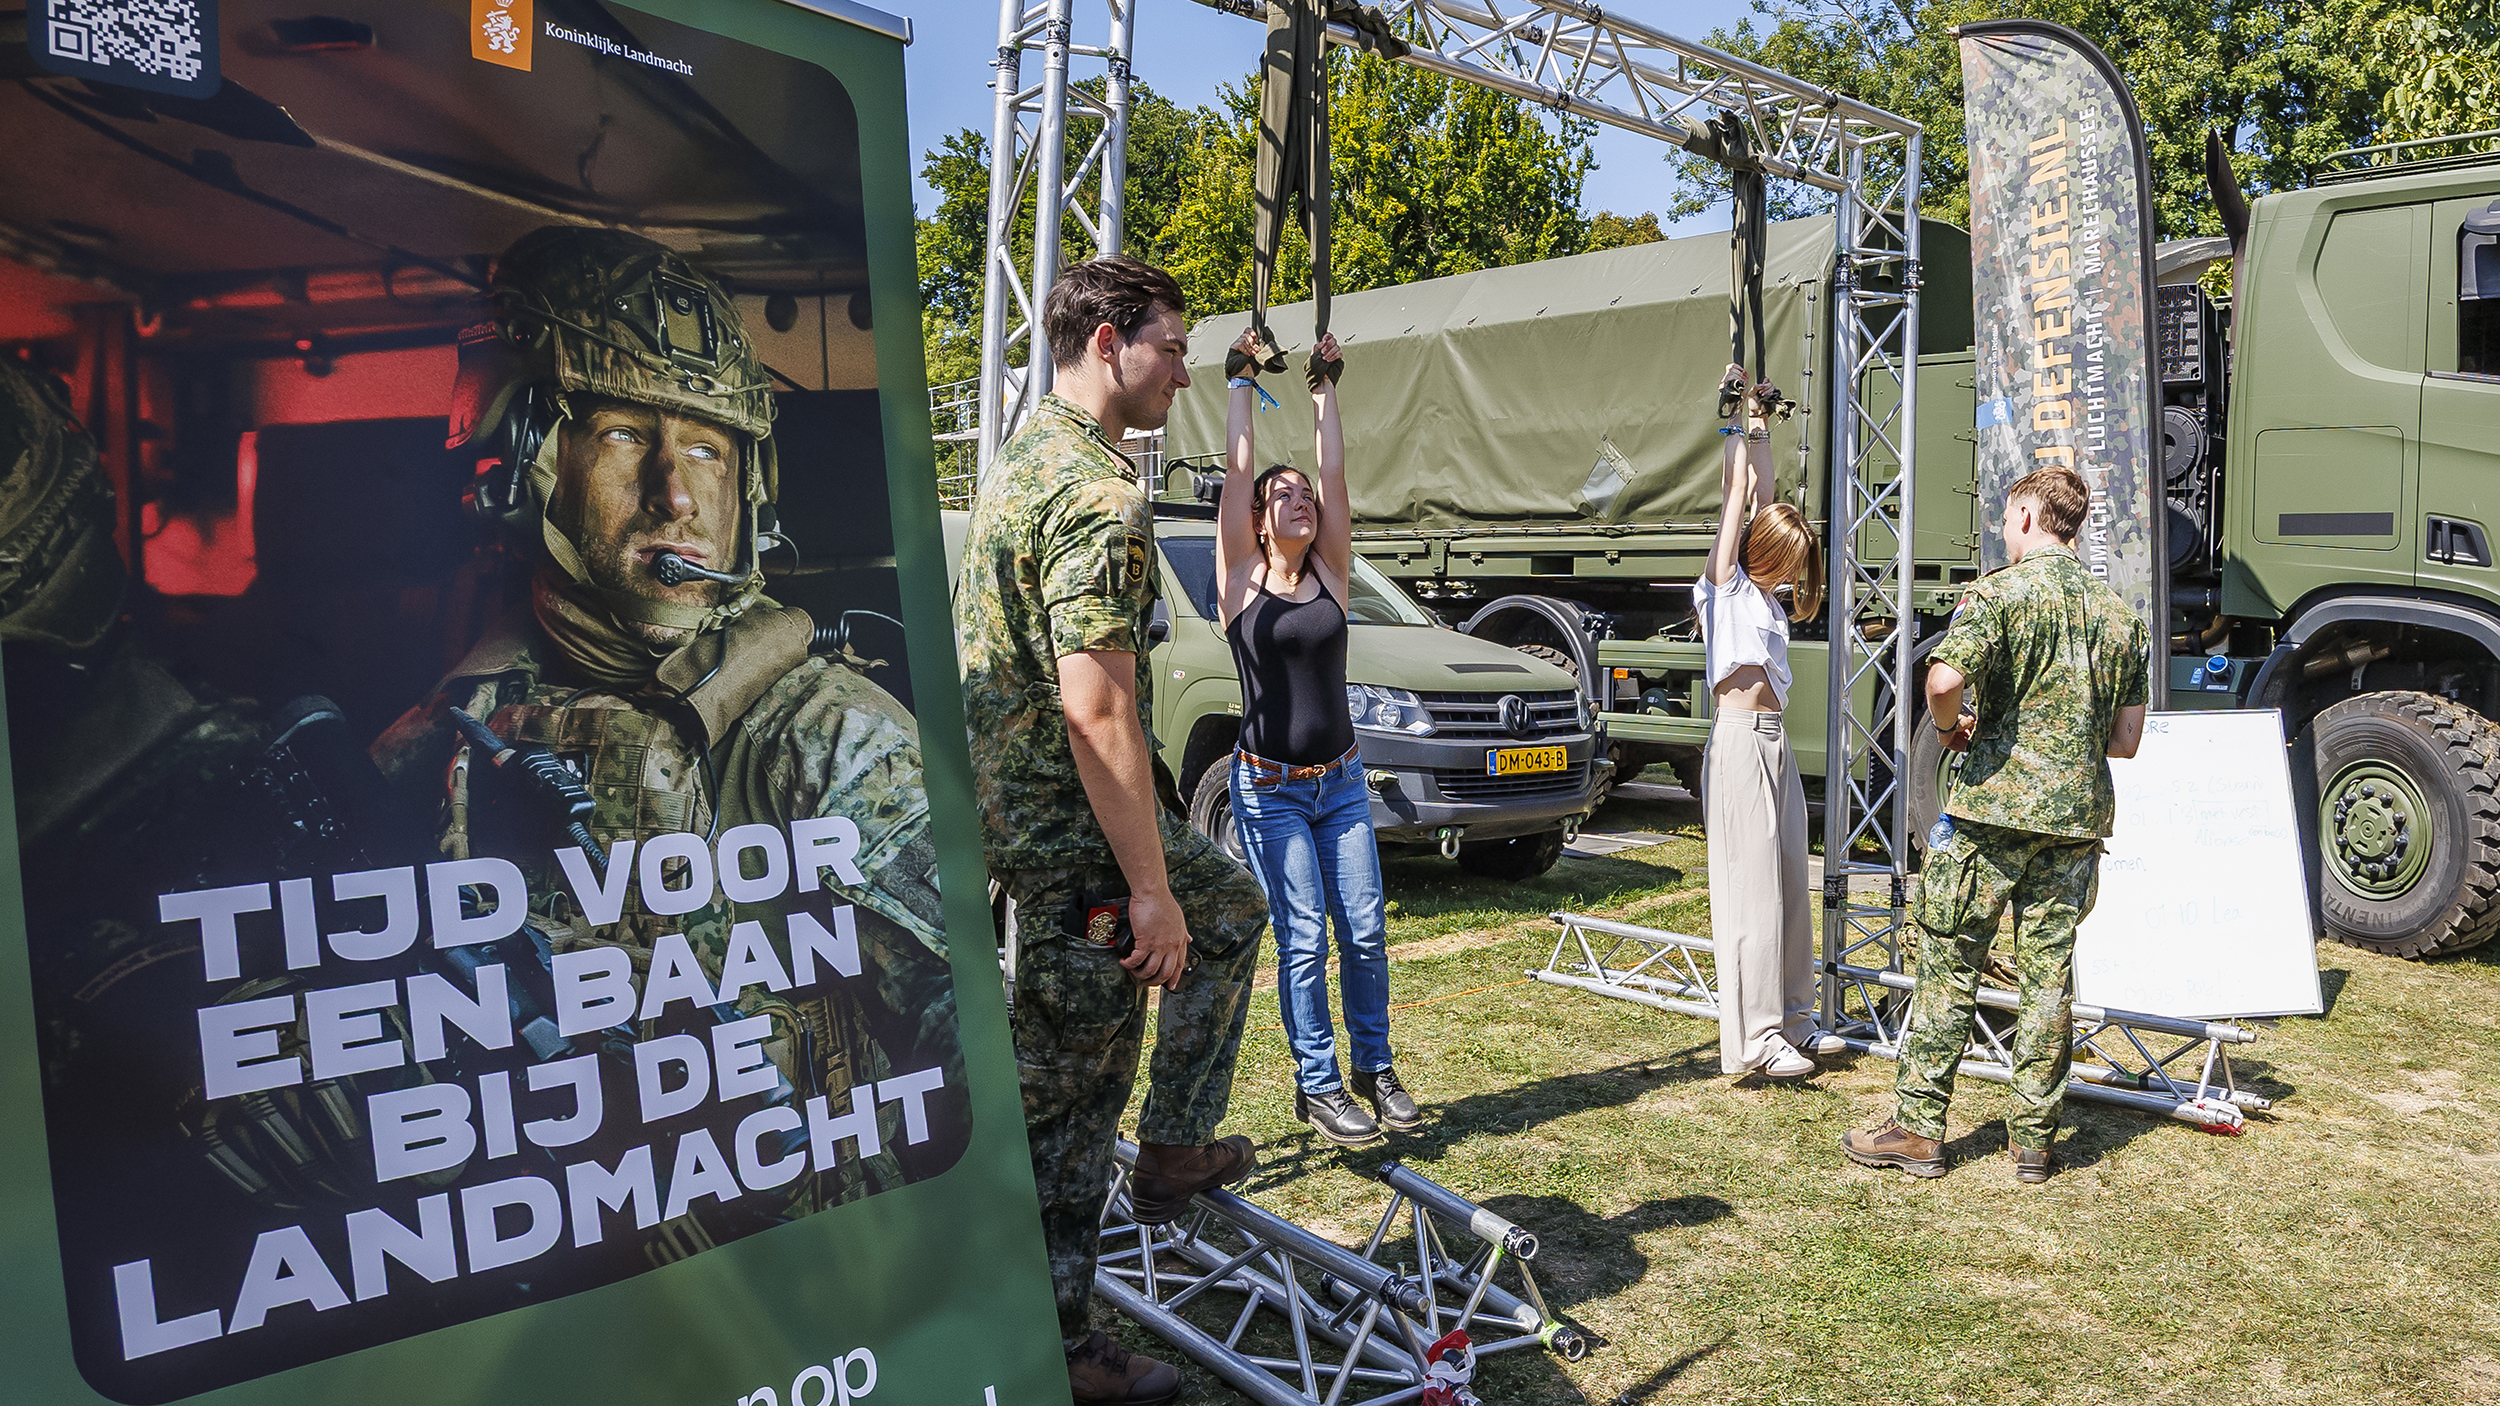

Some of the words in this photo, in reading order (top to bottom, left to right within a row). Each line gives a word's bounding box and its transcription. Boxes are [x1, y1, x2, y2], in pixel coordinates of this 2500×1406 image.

[545, 21, 621, 55] Koninklijke
[623, 44, 694, 76] Landmacht
[2079, 106, 2102, 274] MARECHAUSSEE
[2085, 310, 2106, 451] LUCHTMACHT
[1132, 563, 1140, 576] 13
[1499, 751, 1564, 771] DM-043-B
[158, 856, 529, 983] TIJD
[554, 815, 867, 928] VOOR
[2099, 856, 2148, 873] omen
[197, 963, 513, 1101] EEN
[551, 904, 863, 1038] BAAN
[367, 1053, 604, 1183] BIJ
[634, 1013, 780, 1125] DE
[112, 1066, 946, 1362] LANDMACHT
[790, 1347, 878, 1406] op
